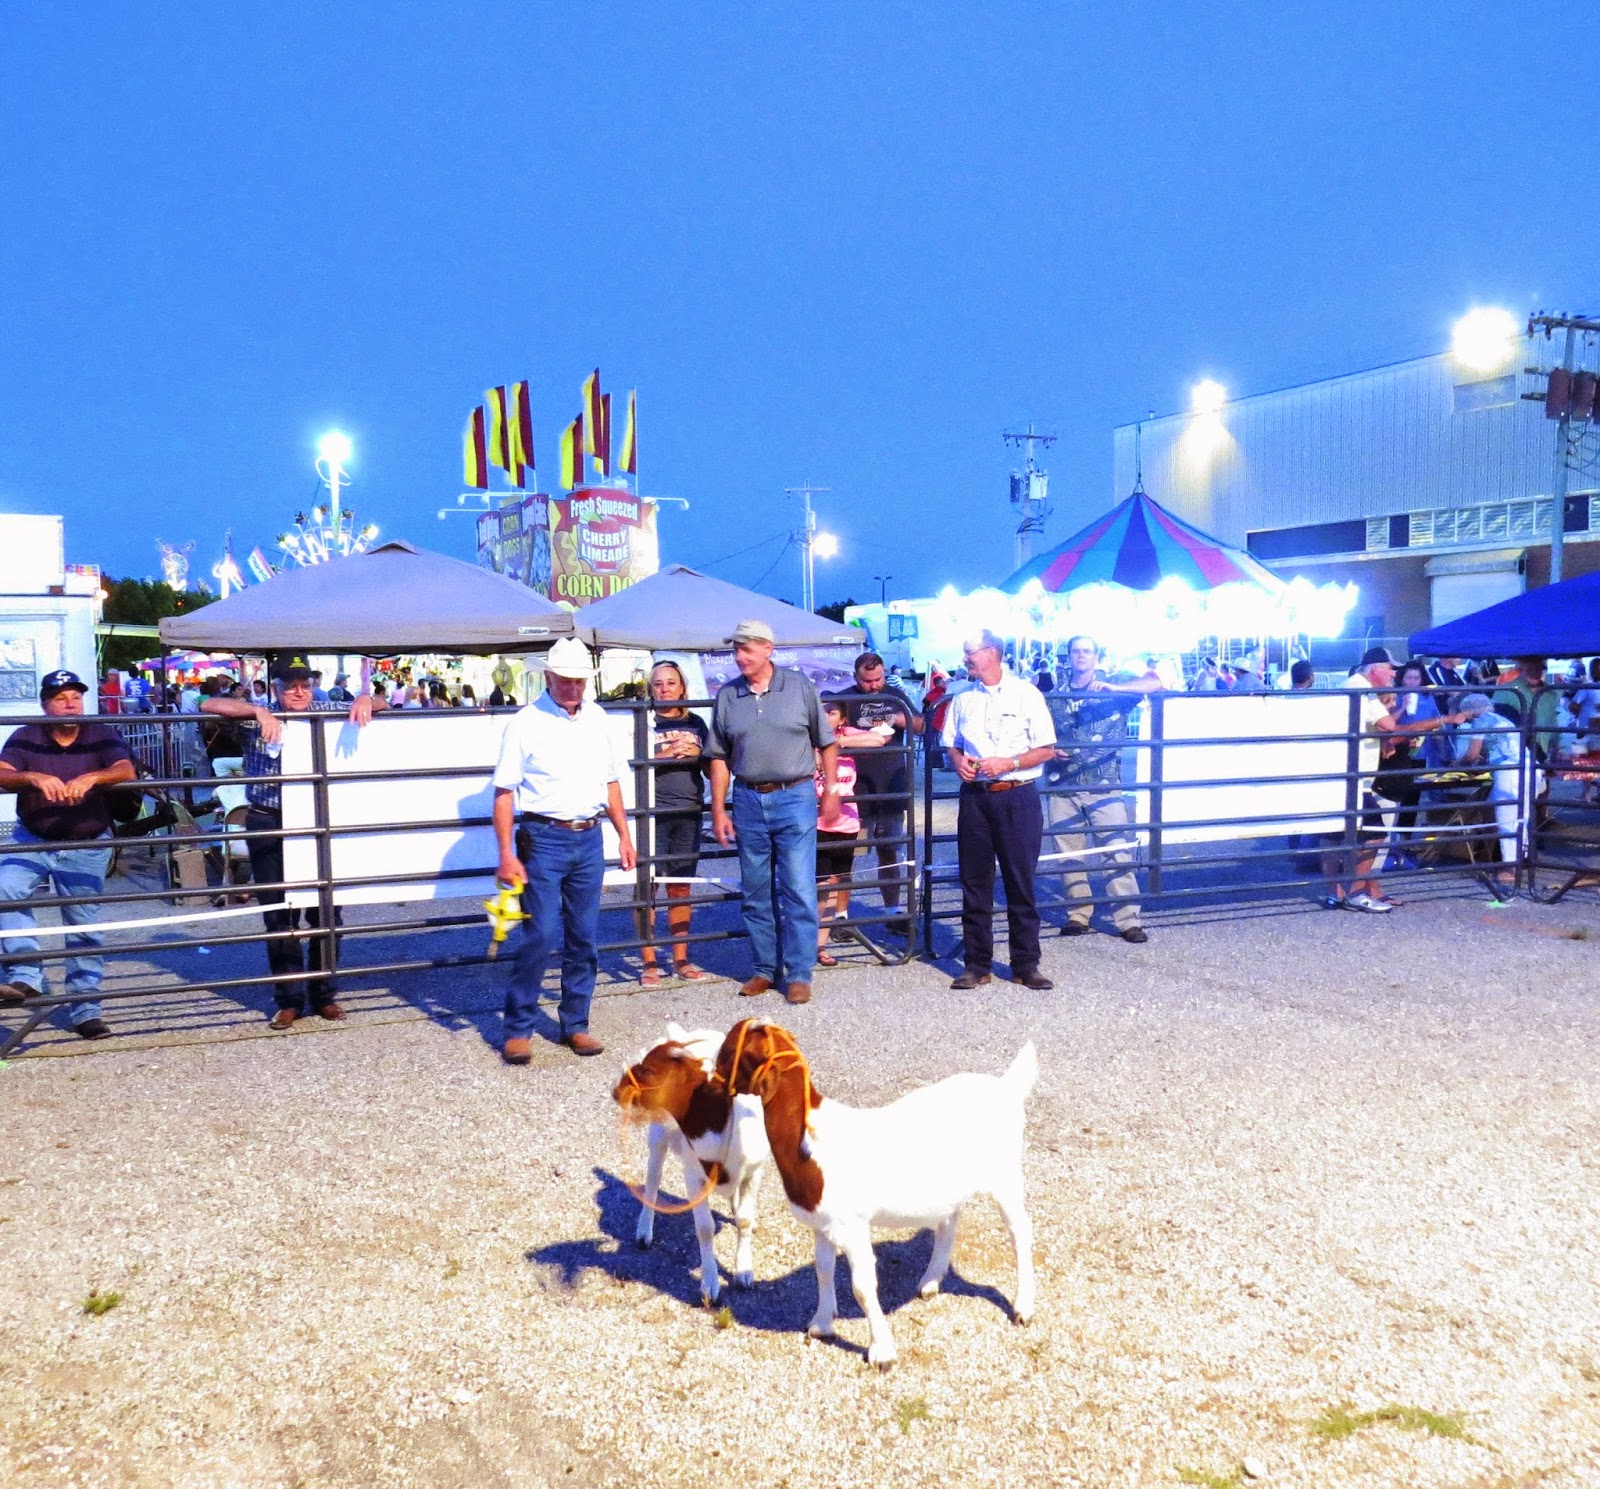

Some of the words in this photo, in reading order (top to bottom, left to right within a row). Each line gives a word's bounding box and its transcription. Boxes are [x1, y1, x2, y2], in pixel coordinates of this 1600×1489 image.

[570, 497, 595, 518] Fresh
[596, 496, 638, 520] Squeezed
[582, 528, 627, 547] CHERRY
[581, 543, 629, 562] LIMEADE
[557, 573, 604, 598] CORN
